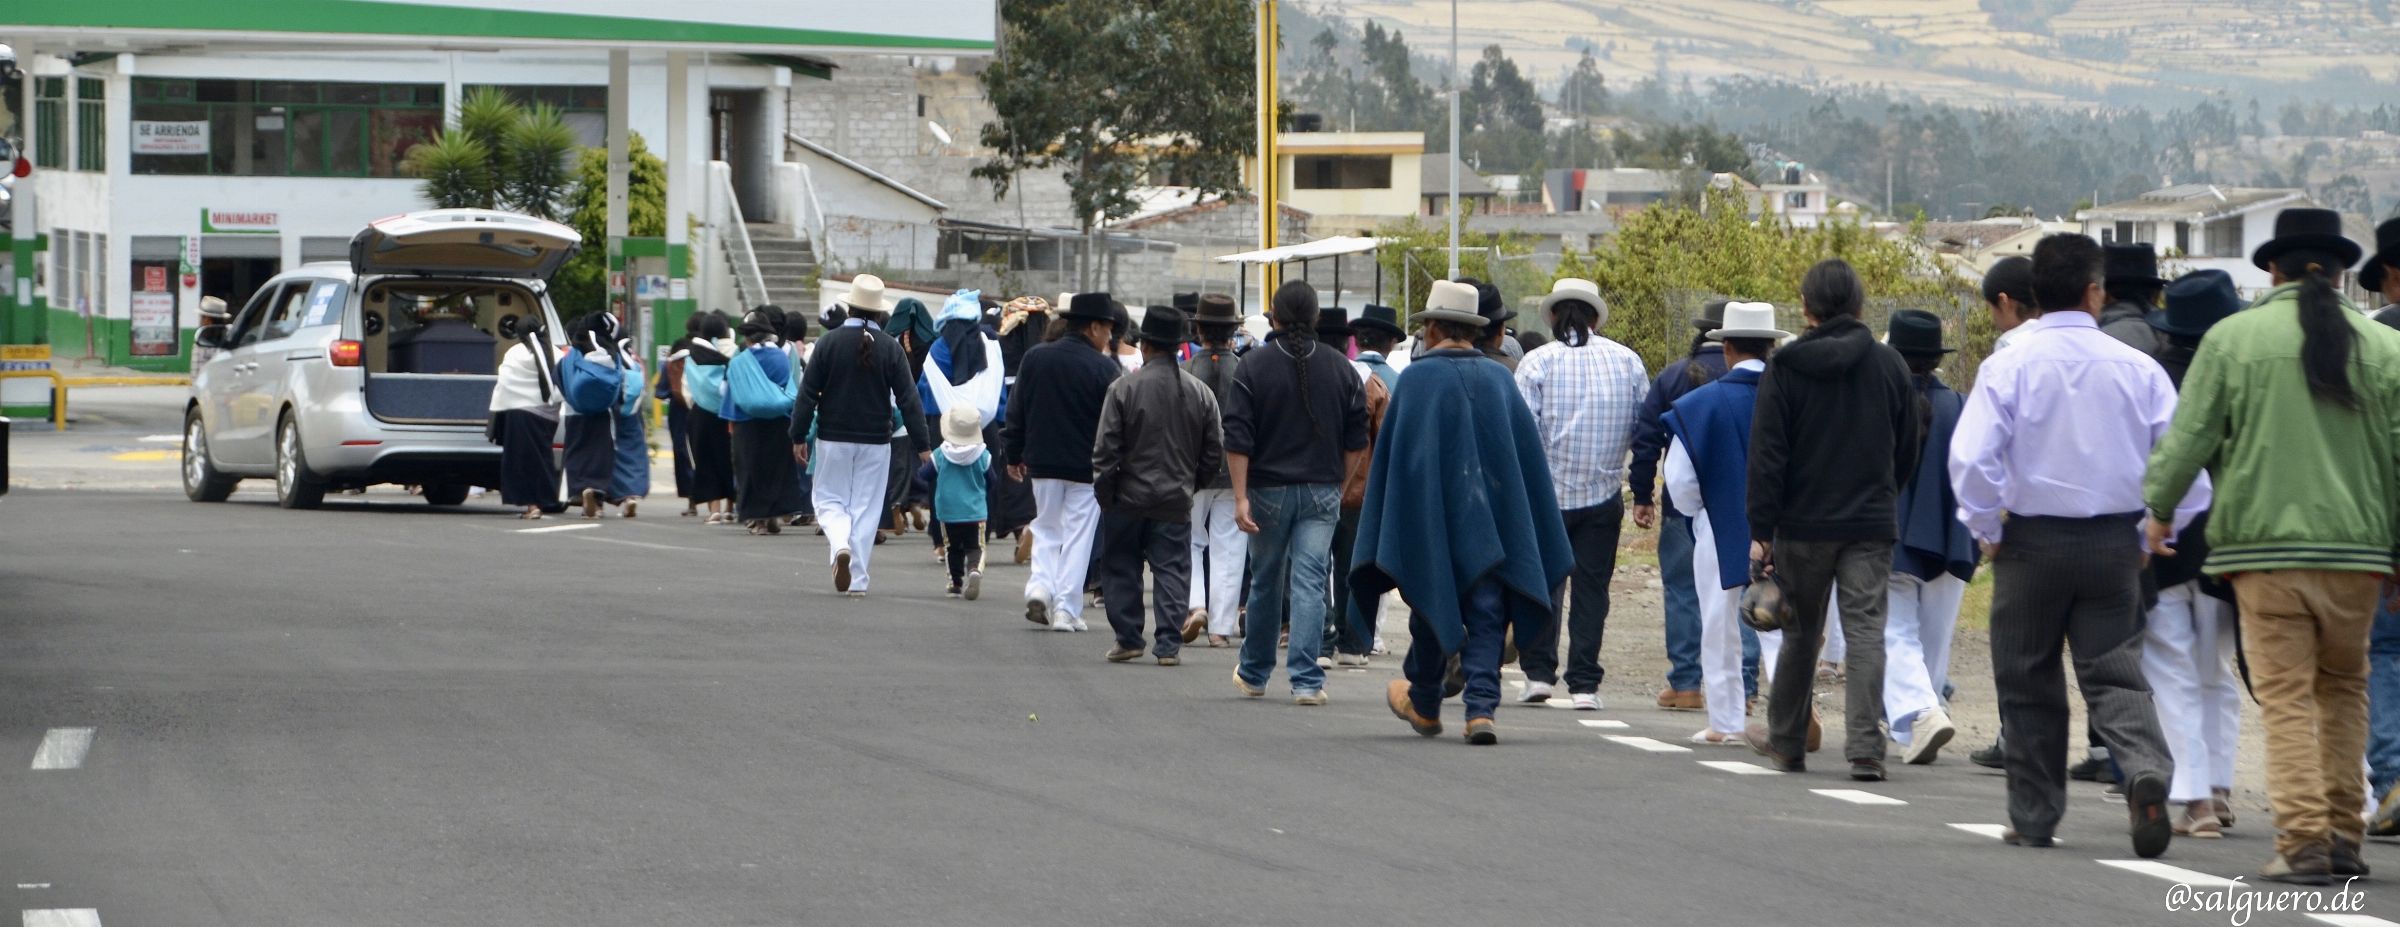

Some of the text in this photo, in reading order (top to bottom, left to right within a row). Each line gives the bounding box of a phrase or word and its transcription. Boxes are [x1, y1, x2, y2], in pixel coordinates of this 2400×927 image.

[140, 124, 200, 137] SE ARRIENDA
[212, 212, 278, 225] MINIMARKET
